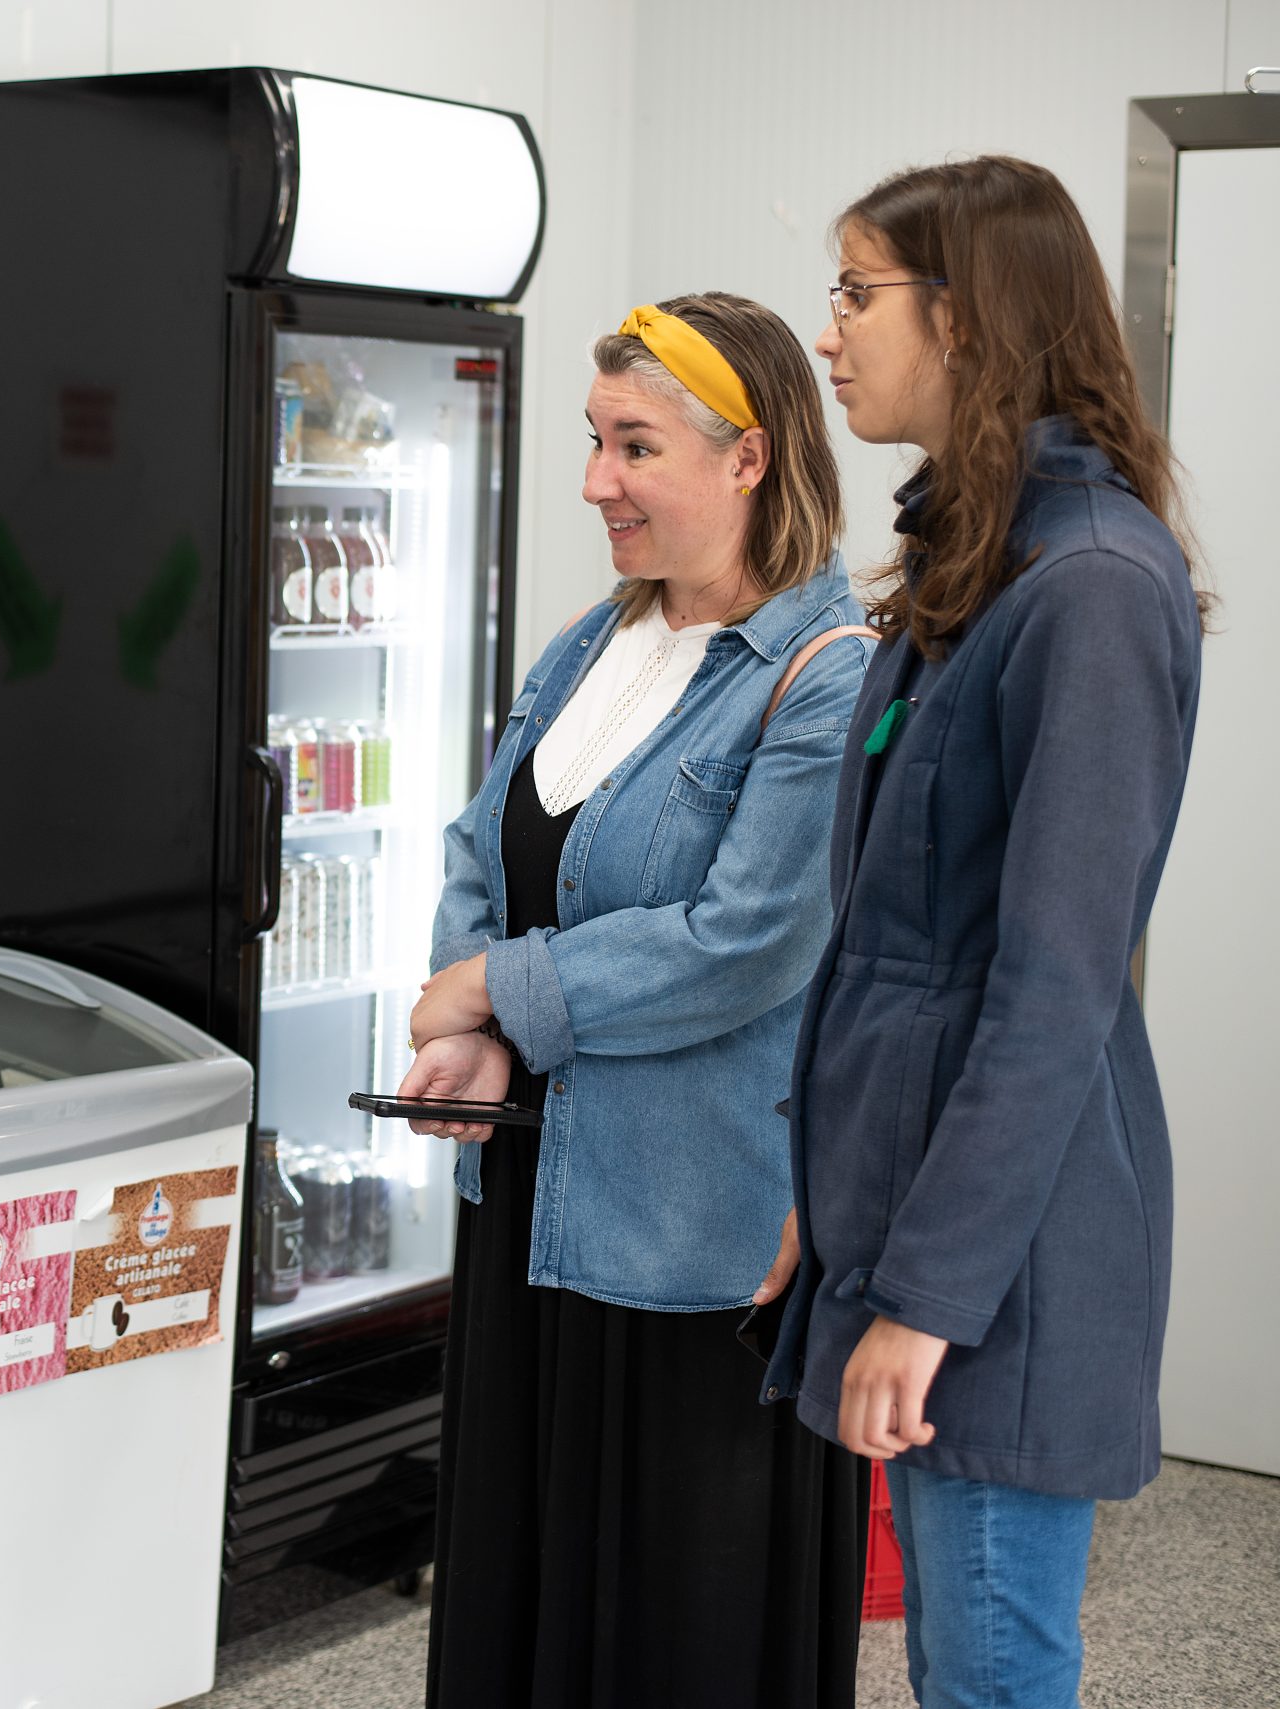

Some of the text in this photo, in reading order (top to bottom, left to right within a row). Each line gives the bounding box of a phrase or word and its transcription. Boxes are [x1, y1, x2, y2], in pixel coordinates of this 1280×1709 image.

[104, 1242, 197, 1272] Crème glacée
[115, 1261, 182, 1286] artisanale
